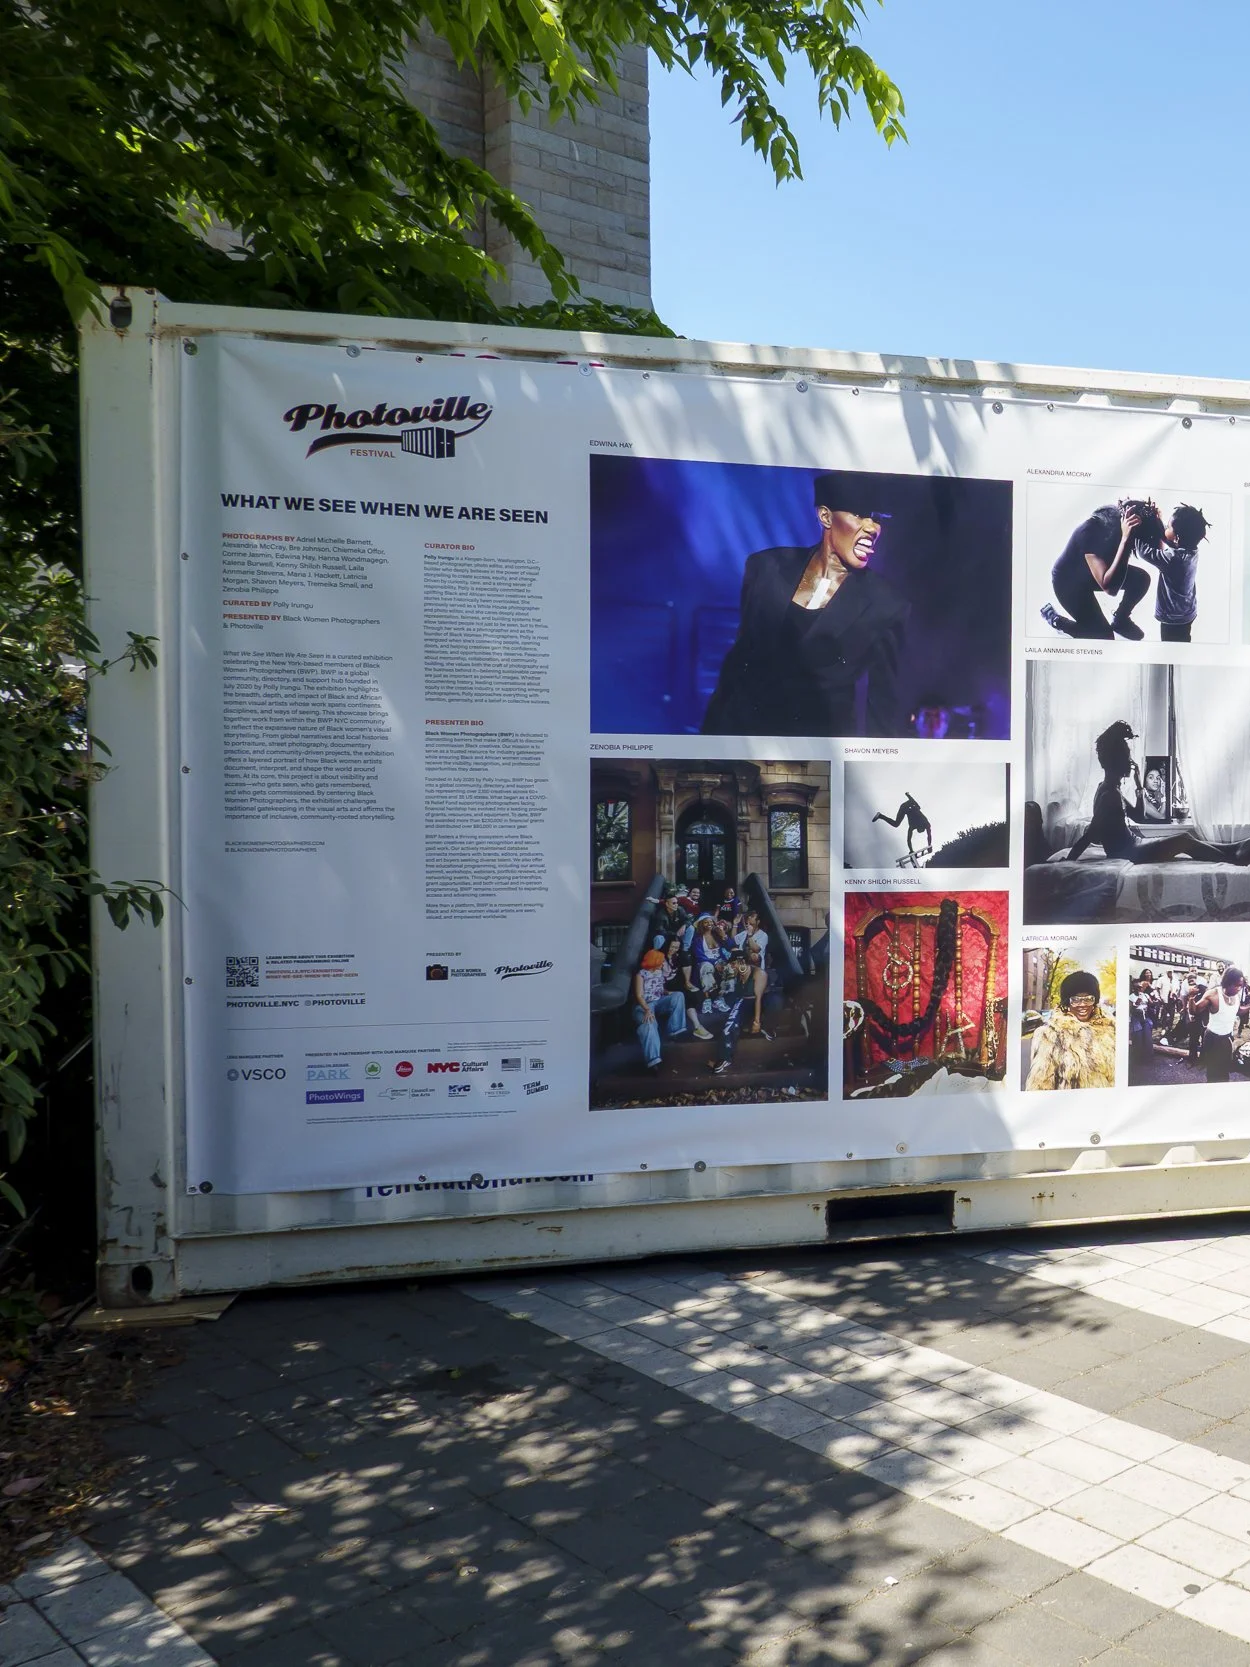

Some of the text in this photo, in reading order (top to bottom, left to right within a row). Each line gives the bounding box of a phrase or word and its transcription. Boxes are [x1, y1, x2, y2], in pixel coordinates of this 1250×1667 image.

[283, 395, 493, 432] Photoville
[589, 439, 618, 447] EDWINA
[350, 448, 396, 458] FESTIVAL
[221, 493, 548, 523] WHAT WE SEE WHEN WE ARE SEEN
[424, 542, 460, 550] CURATOR
[867, 878, 891, 886] SHILOH
[494, 960, 554, 975] Photoville
[427, 1061, 461, 1073] NYC
[242, 1068, 286, 1080] VSCO
[307, 1069, 350, 1081] PARK
[523, 1081, 541, 1090] TEAM
[526, 1085, 549, 1095] DUMBO
[309, 1093, 361, 1102] PhotoWings
